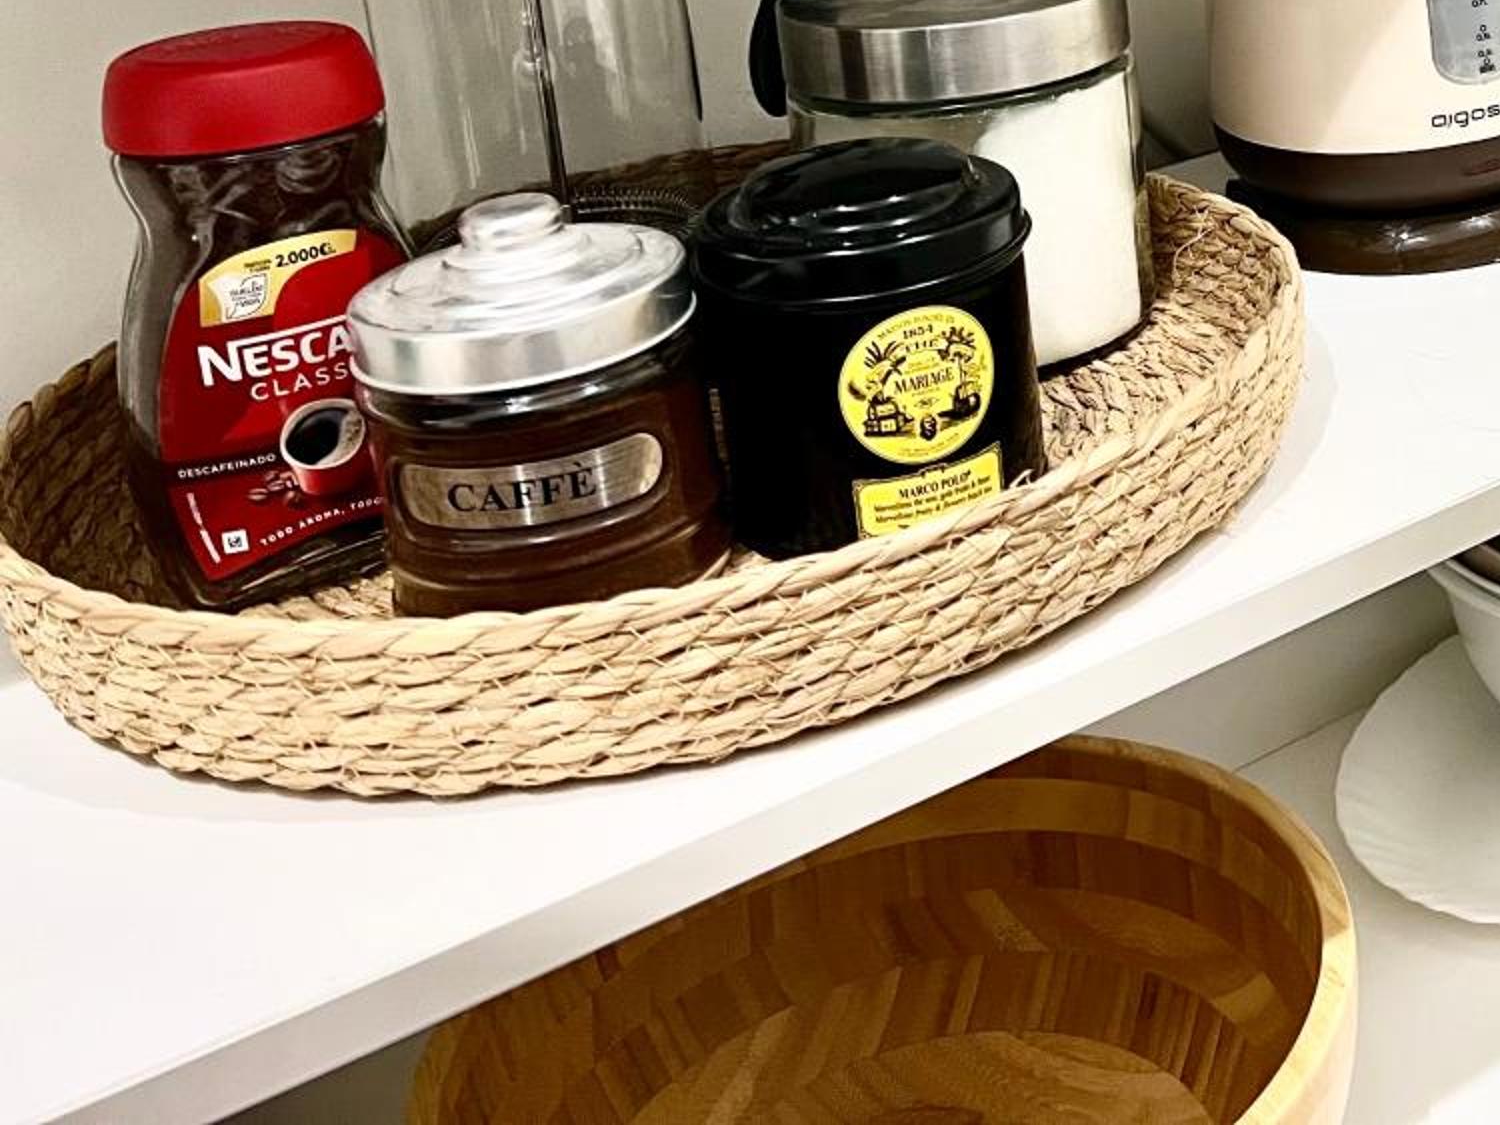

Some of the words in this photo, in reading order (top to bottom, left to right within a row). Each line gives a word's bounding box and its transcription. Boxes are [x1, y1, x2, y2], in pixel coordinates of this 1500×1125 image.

[197, 314, 352, 387] NESCA
[895, 367, 955, 393] MARIAGE
[177, 452, 277, 479] DESCAFEINADO
[447, 462, 597, 512] CAFFÈ
[898, 483, 939, 500] MARCO
